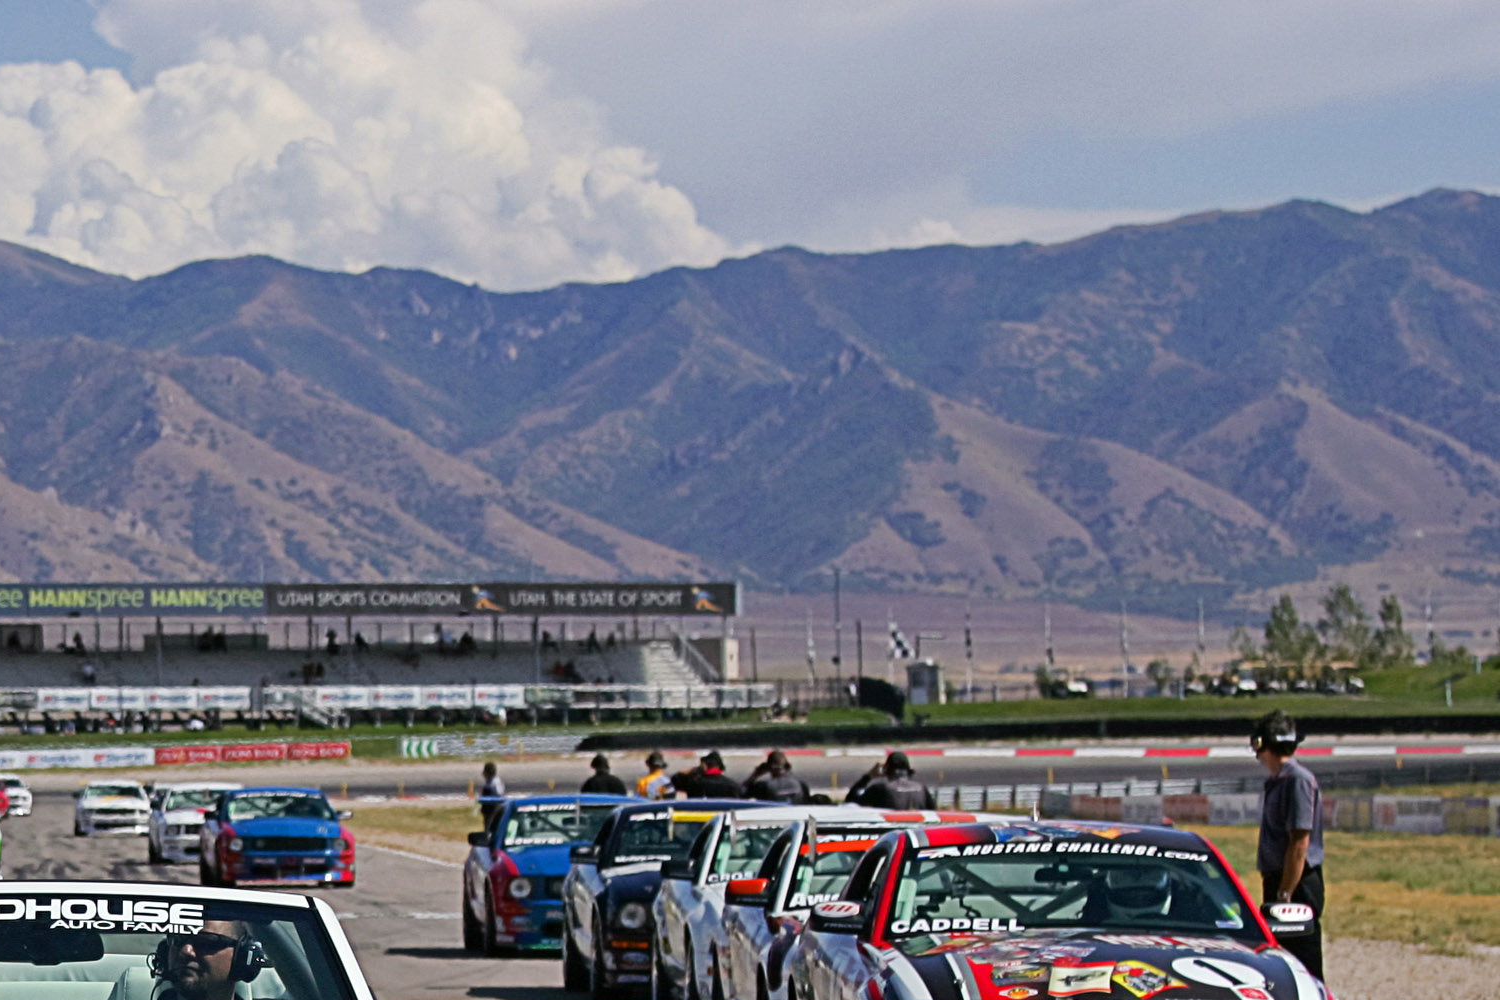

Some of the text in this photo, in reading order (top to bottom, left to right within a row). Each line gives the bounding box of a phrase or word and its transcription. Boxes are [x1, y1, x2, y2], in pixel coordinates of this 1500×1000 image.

[29, 588, 144, 612] HANNspree
[151, 588, 264, 612] HANNspree
[277, 591, 461, 606] UTAH SPORTS COMMISSION
[553, 590, 576, 606] THE
[580, 590, 615, 606] STATE
[618, 590, 637, 606] OF
[642, 590, 682, 606] SPORT
[50, 920, 204, 935] AUTO FAMILY
[891, 918, 1025, 933] CADDELL
